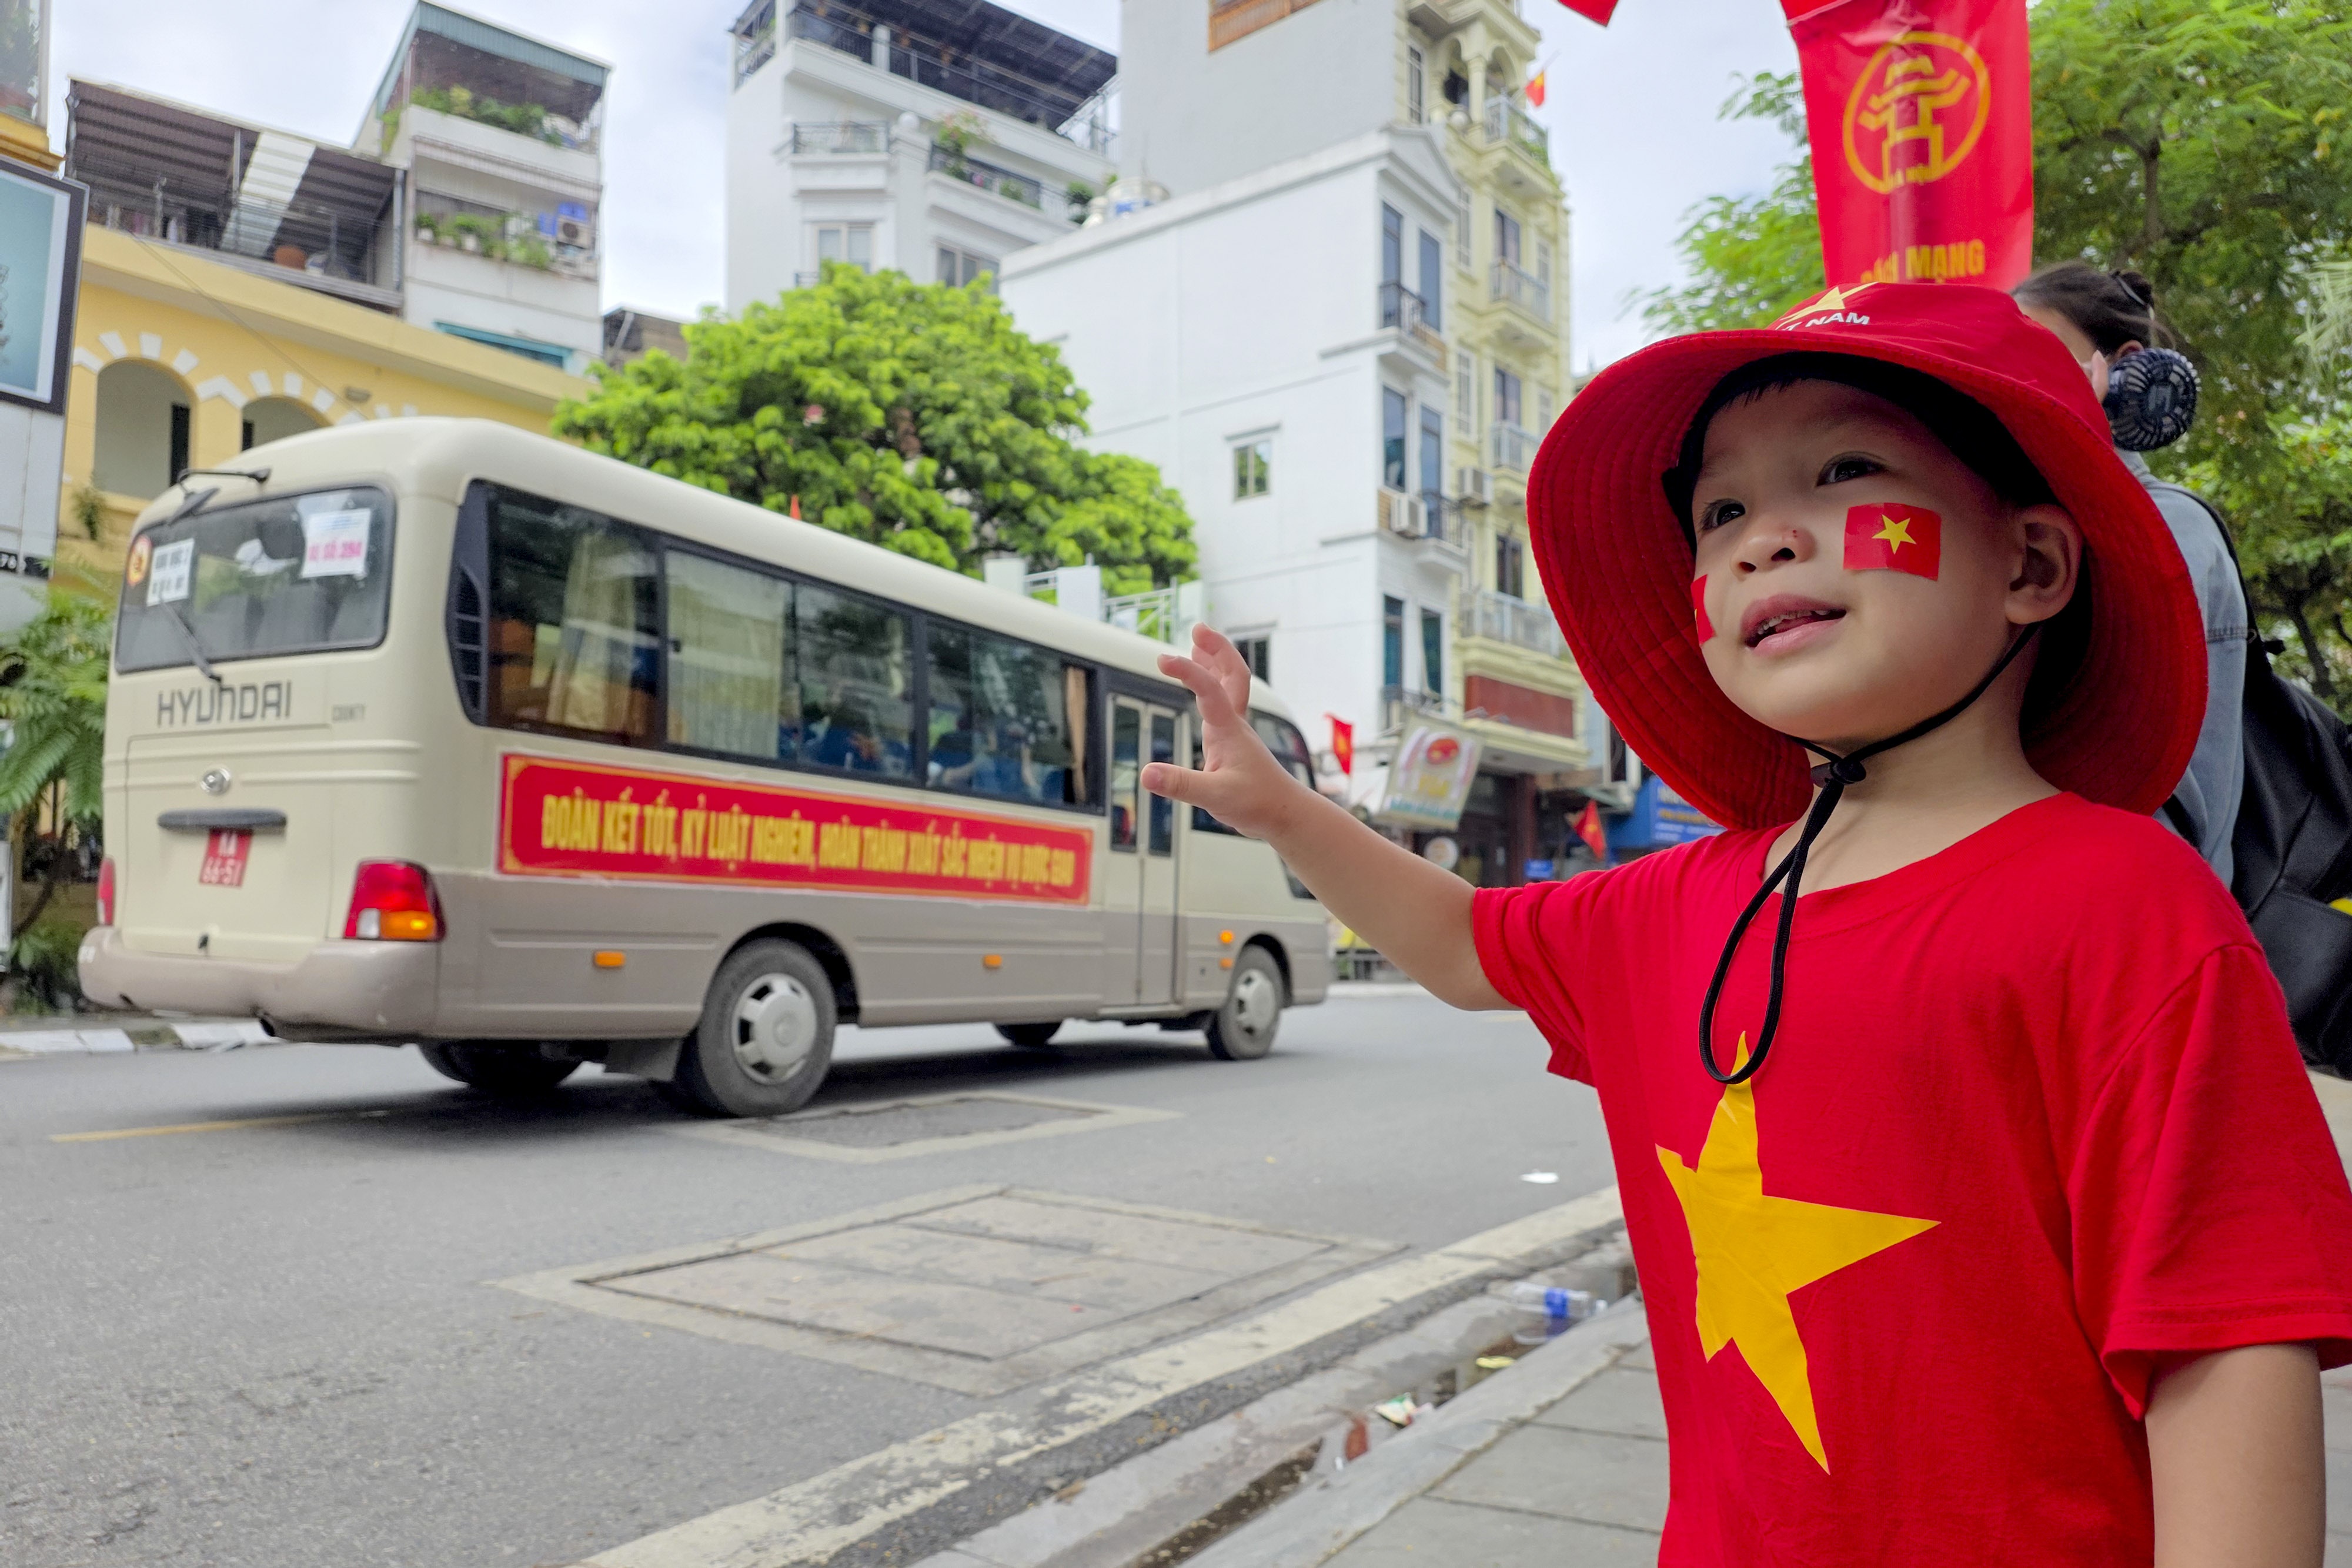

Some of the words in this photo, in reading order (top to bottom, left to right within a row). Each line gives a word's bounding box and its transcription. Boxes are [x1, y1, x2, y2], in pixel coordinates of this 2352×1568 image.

[1906, 239, 1985, 285] MẠNG
[1805, 312, 1870, 327] NAM
[156, 680, 293, 728] HYUNDAI
[542, 786, 600, 852] ĐOÀN
[602, 785, 639, 854] KẾT
[708, 803, 751, 872] LUẬT
